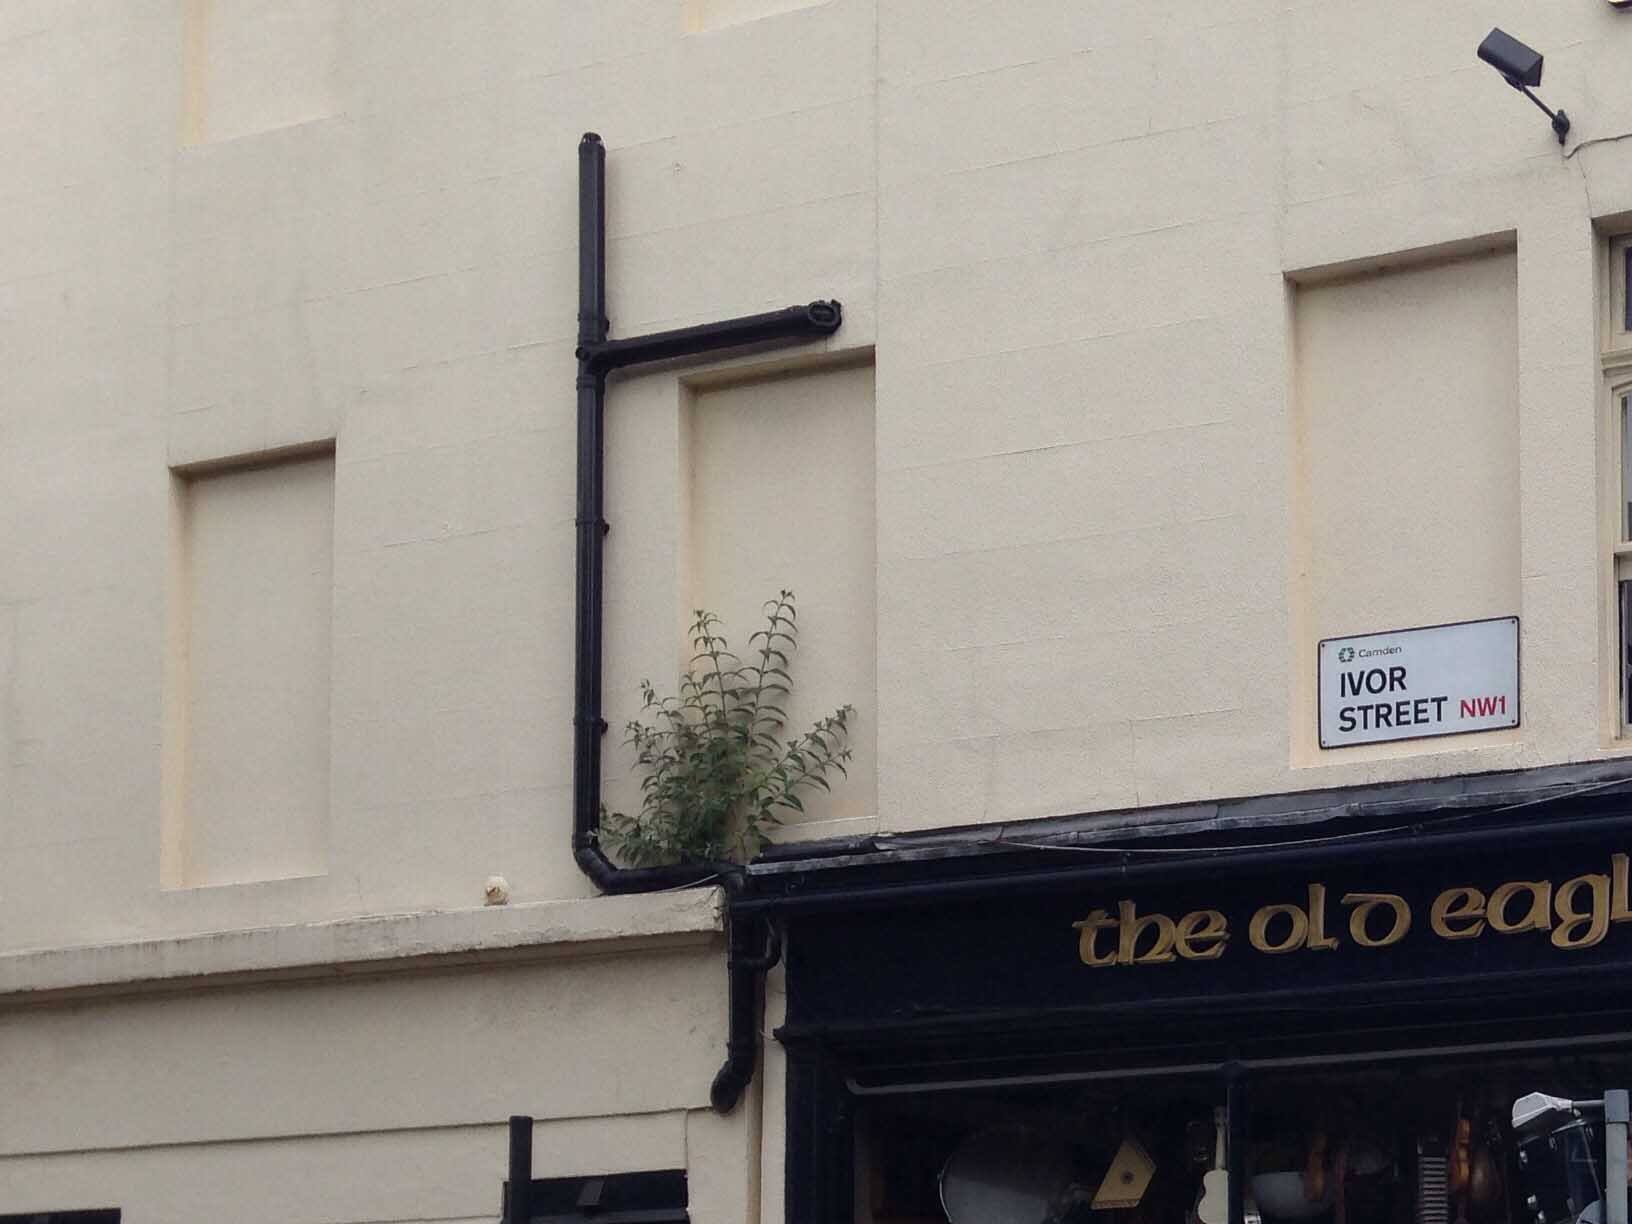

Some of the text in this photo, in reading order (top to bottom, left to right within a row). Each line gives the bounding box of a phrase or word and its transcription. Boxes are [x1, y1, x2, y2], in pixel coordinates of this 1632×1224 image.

[1358, 645, 1402, 659] Camden
[1339, 666, 1408, 698] IVOR
[1339, 695, 1507, 733] STREET NW1
[1072, 899, 1232, 967] the
[1248, 883, 1414, 952] old
